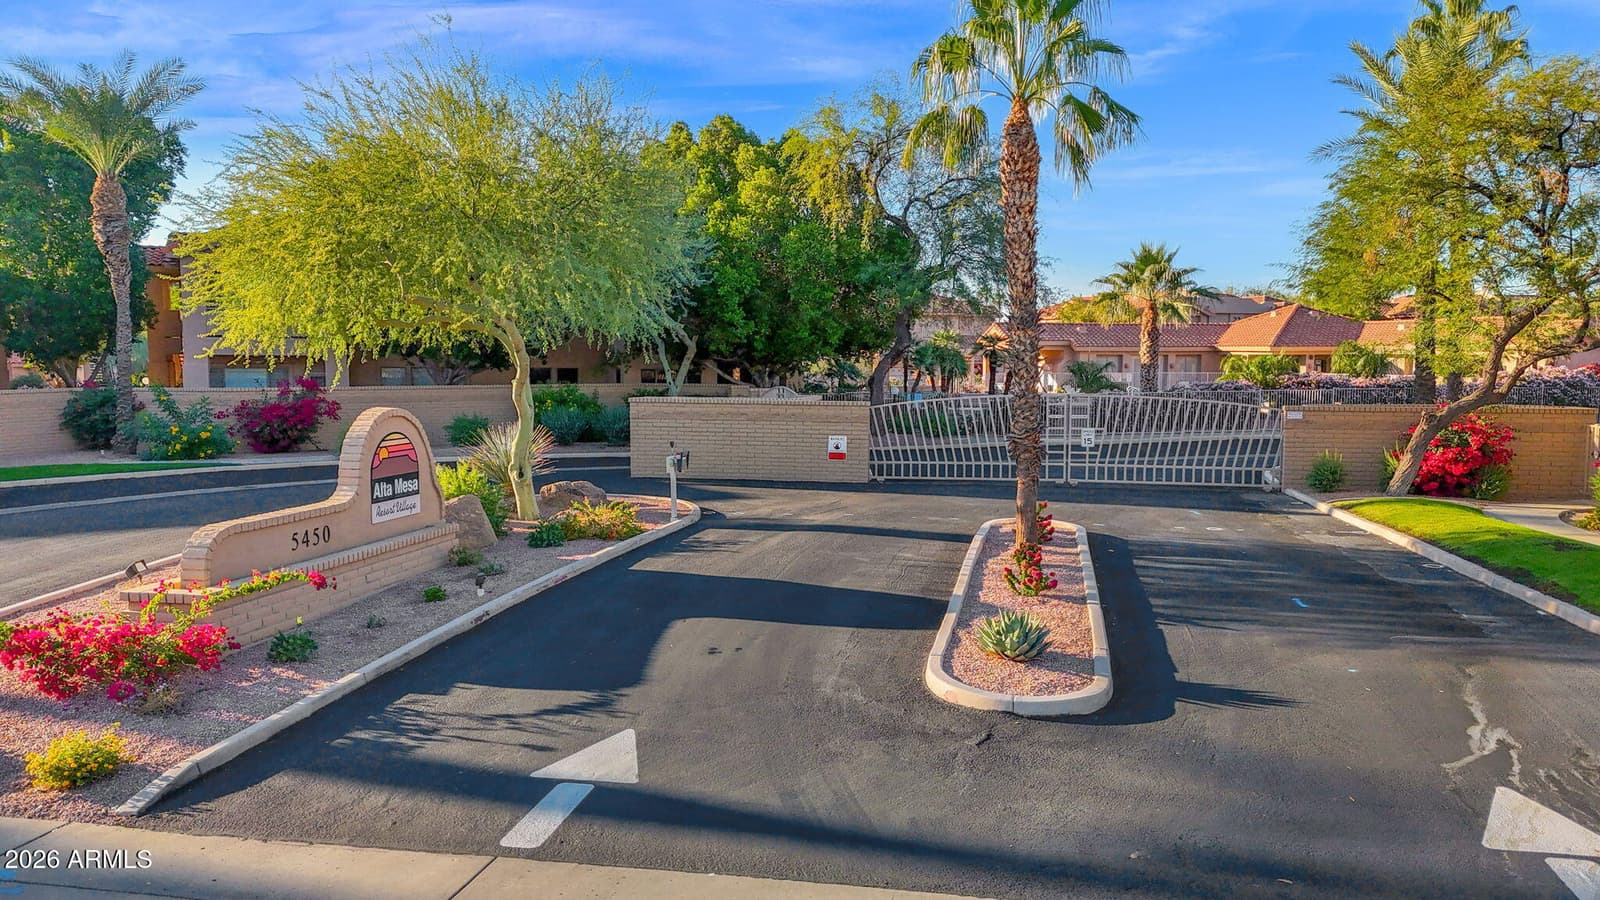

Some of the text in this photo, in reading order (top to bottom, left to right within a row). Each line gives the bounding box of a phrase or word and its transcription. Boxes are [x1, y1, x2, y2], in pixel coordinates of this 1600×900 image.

[373, 477, 418, 499] Alta Mesa
[375, 500, 417, 518] Resort Village
[291, 525, 331, 551] 5450
